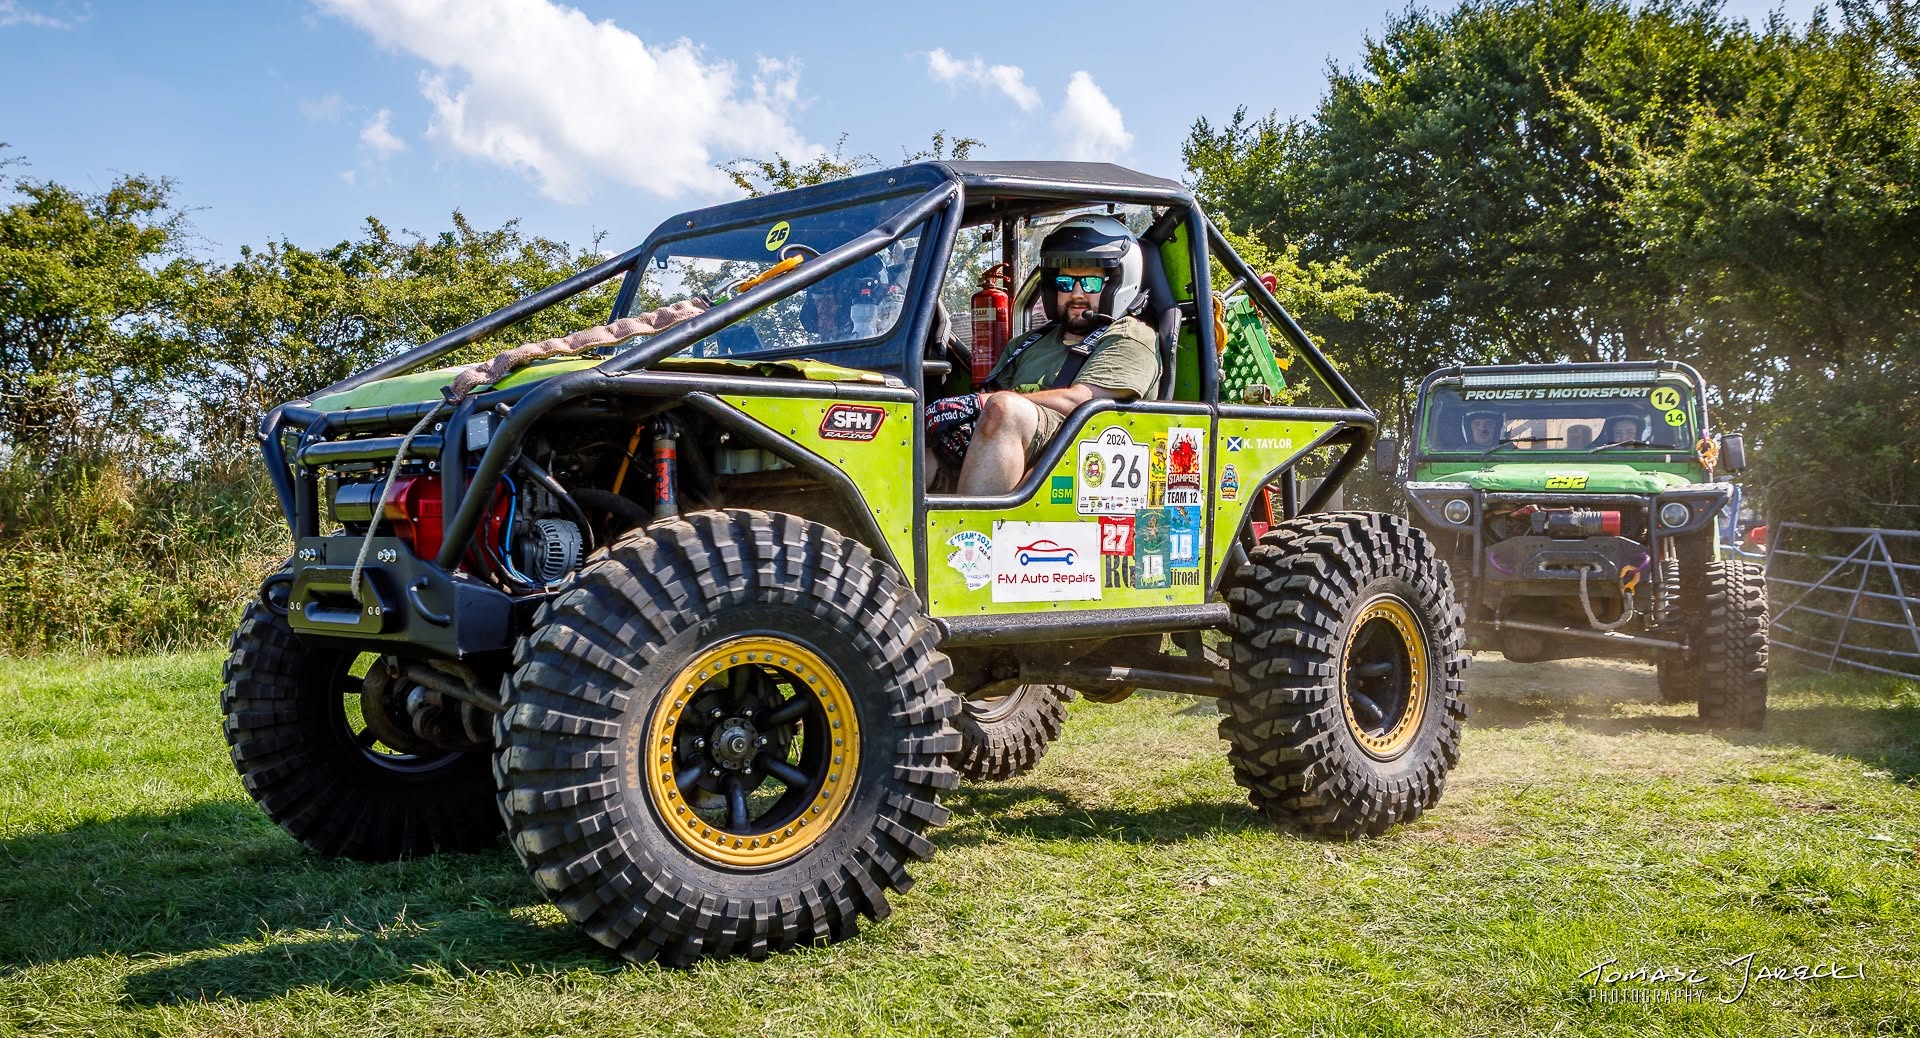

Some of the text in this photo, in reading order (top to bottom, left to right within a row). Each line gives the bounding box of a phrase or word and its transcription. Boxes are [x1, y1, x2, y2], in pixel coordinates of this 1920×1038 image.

[767, 226, 788, 245] 26
[1465, 387, 1651, 401] PROUSEY'S MOTORSPORT
[1655, 392, 1676, 405] 14
[833, 410, 872, 430] SFM
[1667, 413, 1684, 423] 14
[825, 432, 873, 440] RACING
[1106, 434, 1126, 446] 2024
[1243, 438, 1292, 449] K. TAYLOR
[1111, 454, 1141, 489] 26
[655, 462, 669, 502] FOX
[1168, 473, 1200, 485] STAMPEDE
[1545, 475, 1589, 489] 292
[1052, 488, 1072, 499] GSM
[1168, 491, 1198, 503] TEAM 12
[1102, 523, 1130, 552] 27
[1170, 533, 1193, 559] 15
[1142, 554, 1164, 577] 15
[1021, 573, 1049, 584] Auto
[1052, 573, 1095, 584] Repairs
